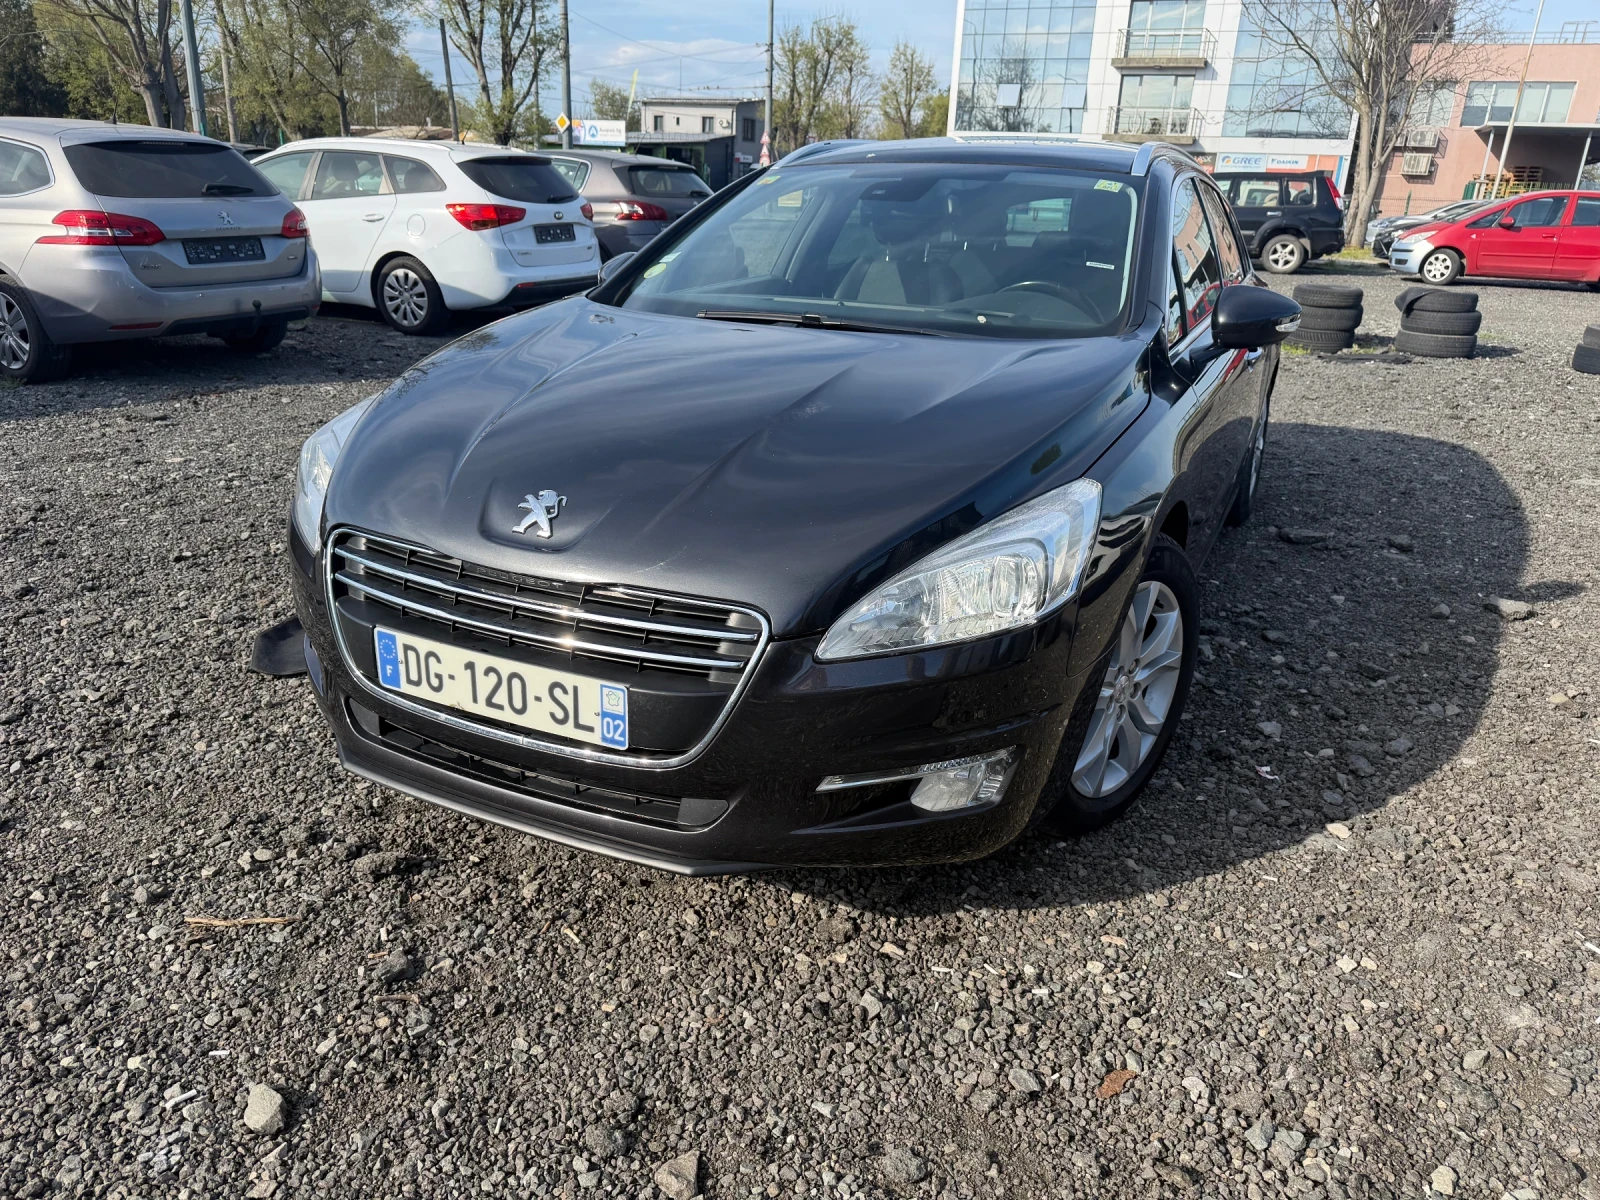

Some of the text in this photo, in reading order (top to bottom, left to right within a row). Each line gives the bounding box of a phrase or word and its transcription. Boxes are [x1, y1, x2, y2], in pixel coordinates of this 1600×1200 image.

[1232, 156, 1262, 165] GREE
[386, 665, 393, 677] F
[402, 642, 596, 734] DG-120-SL
[603, 717, 625, 742] 02
